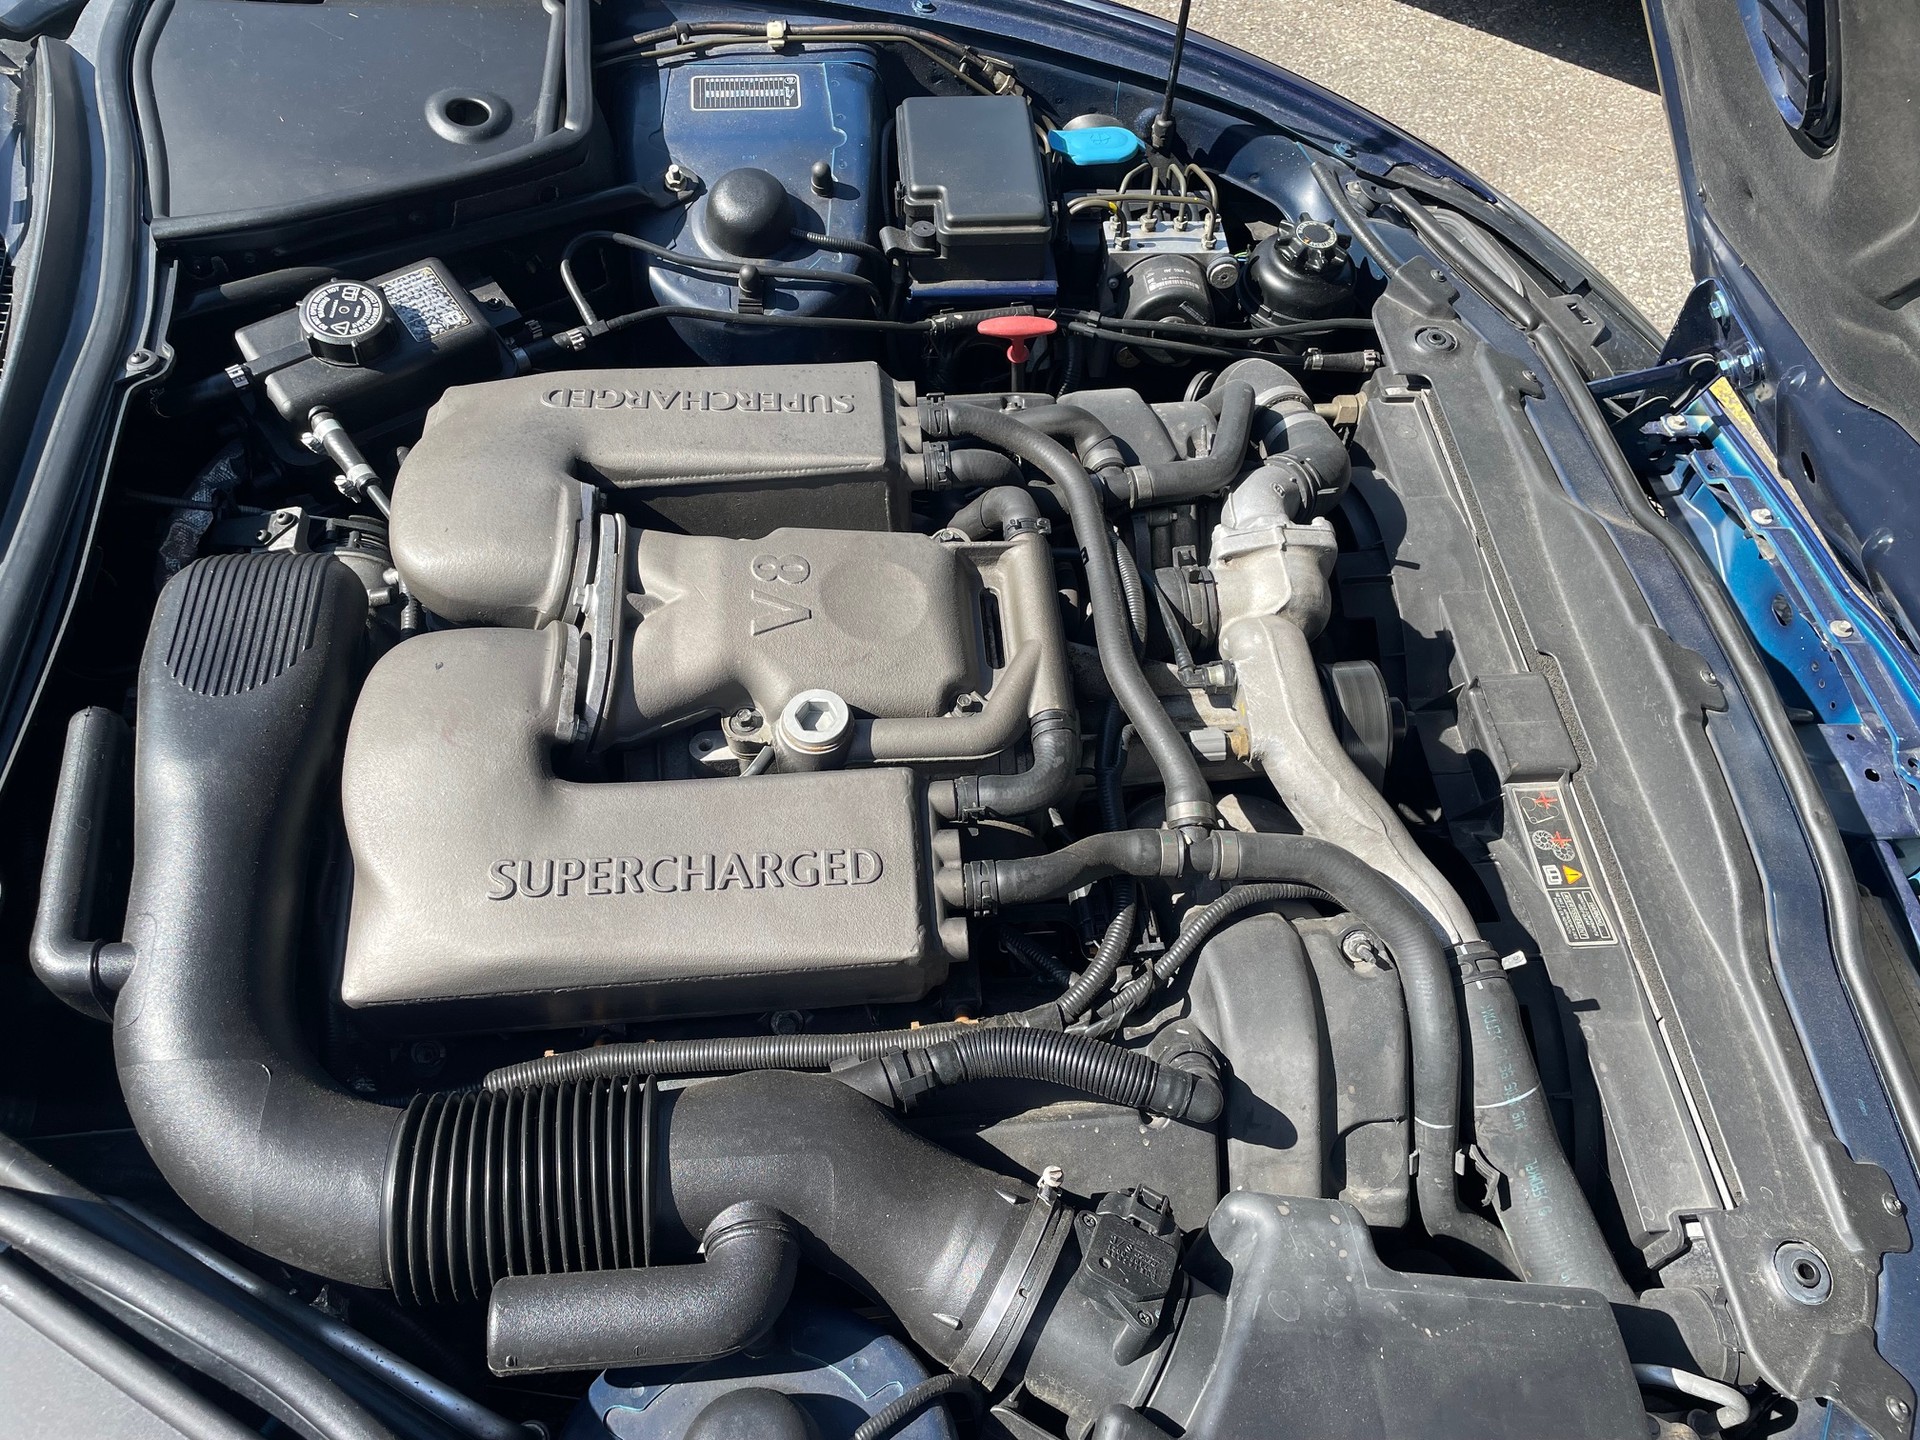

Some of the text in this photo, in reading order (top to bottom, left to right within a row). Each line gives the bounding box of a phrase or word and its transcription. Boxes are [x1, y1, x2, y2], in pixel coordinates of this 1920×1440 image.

[326, 286, 340, 294] HOT
[541, 388, 855, 414] SUPERCHARGED
[750, 553, 812, 636] V8
[488, 848, 884, 900] SUPERCHARGED
